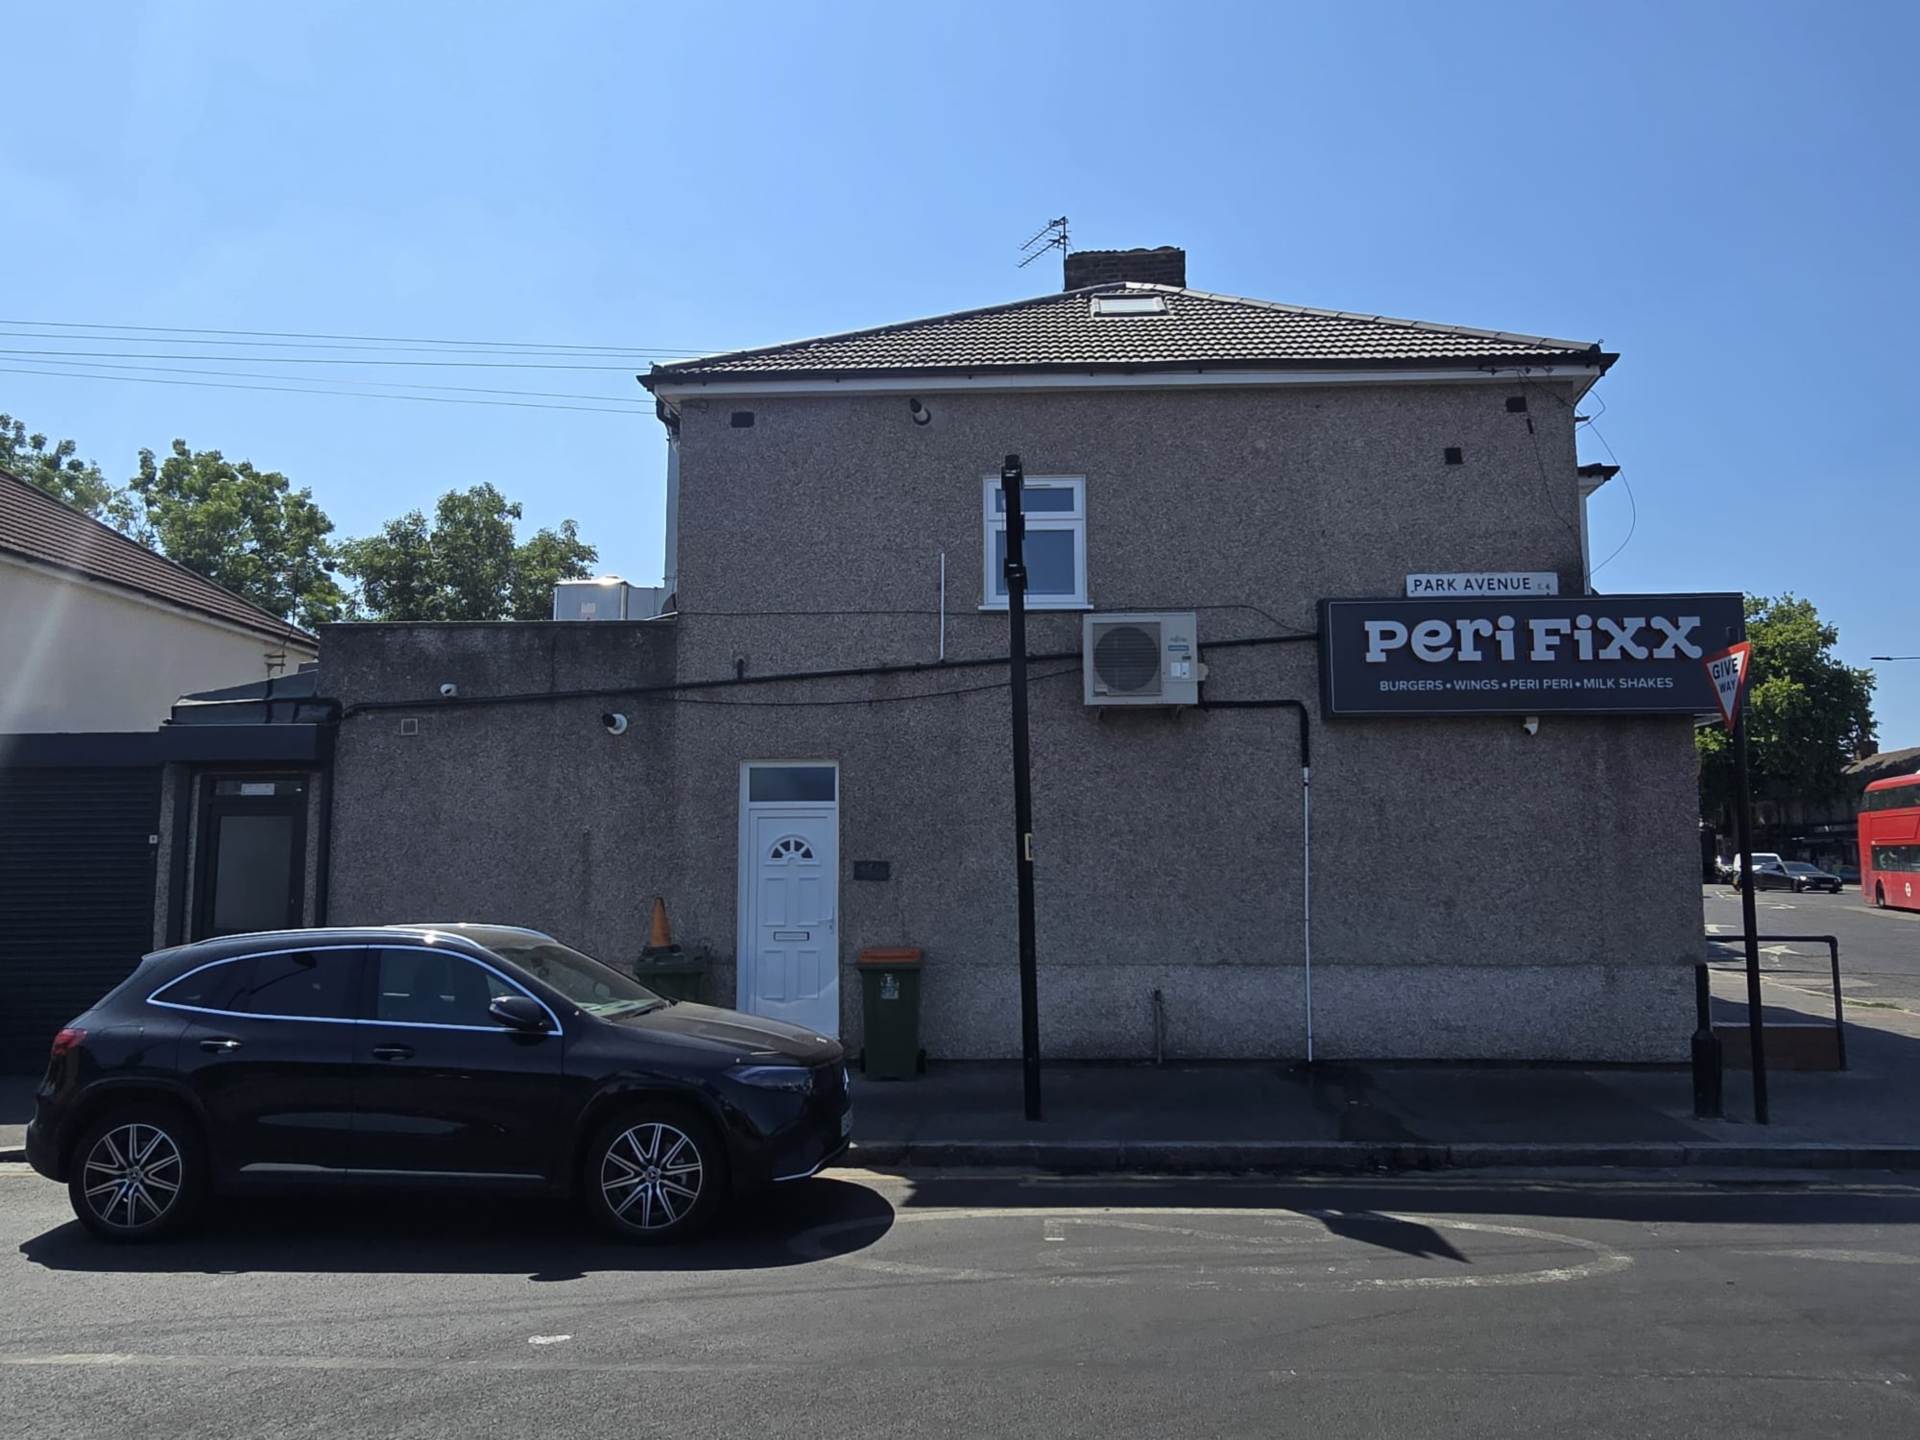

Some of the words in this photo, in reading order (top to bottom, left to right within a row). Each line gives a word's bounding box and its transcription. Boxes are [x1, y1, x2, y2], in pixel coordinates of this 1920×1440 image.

[1413, 578, 1457, 591] PARK
[1464, 577, 1532, 591] AVENUE
[1712, 657, 1739, 679] GIVE
[1379, 680, 1443, 691] BURGERS
[1453, 679, 1500, 690] WINGS
[1509, 679, 1540, 690] PERI
[1543, 679, 1573, 689] PERI
[1583, 678, 1616, 689] MILK
[1619, 677, 1674, 689] SHAKES
[1719, 679, 1736, 693] WAY
